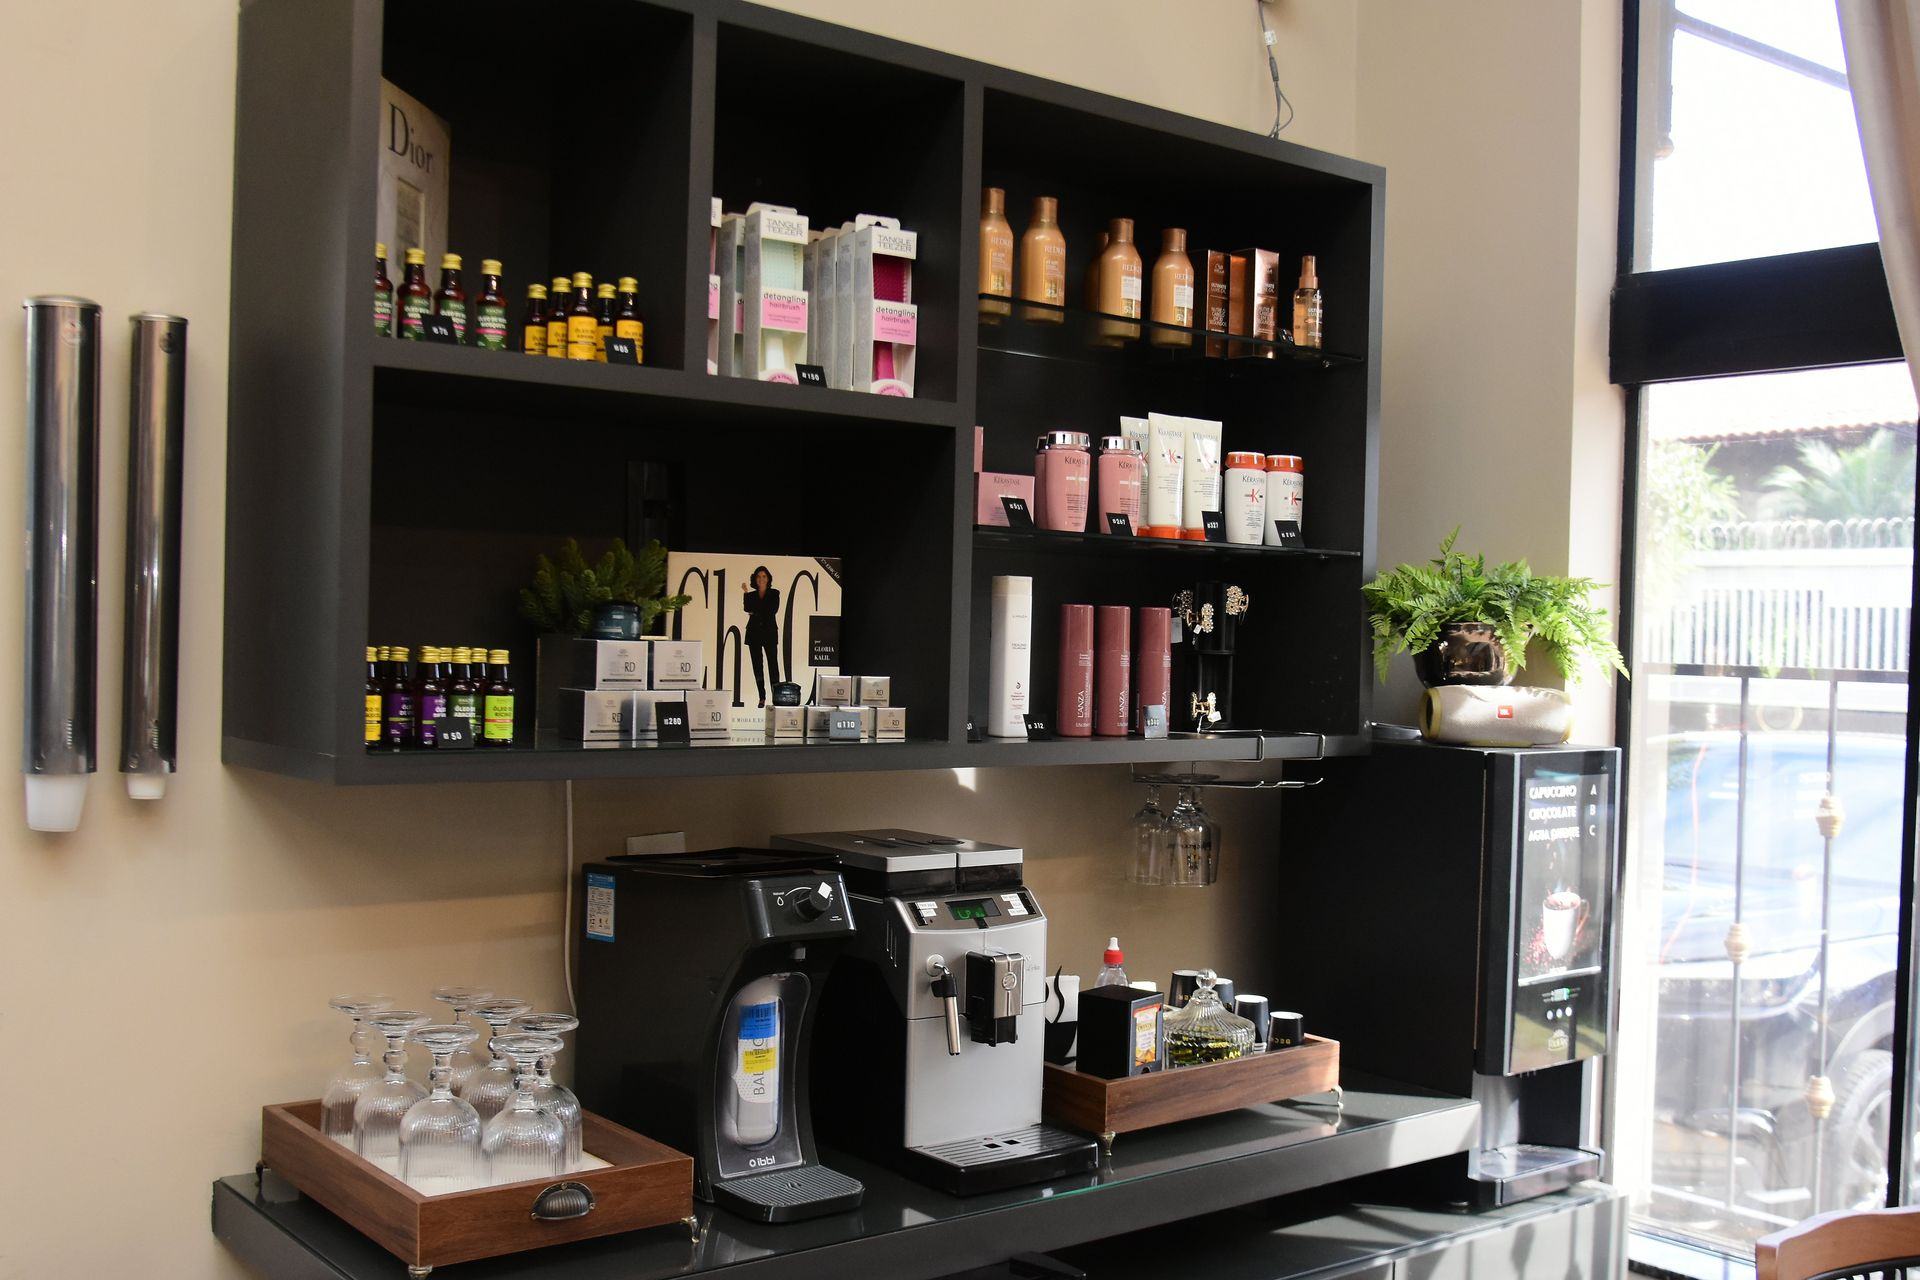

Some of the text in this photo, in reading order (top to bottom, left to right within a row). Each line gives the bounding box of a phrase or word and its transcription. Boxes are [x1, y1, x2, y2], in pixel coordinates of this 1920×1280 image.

[388, 102, 433, 174] Dior
[767, 218, 803, 228] TANGLE
[767, 225, 804, 237] TEEZER
[879, 235, 912, 246] TANGLE
[880, 243, 912, 253] TEEZER
[763, 293, 806, 305] detangling
[769, 302, 800, 311] hairbrush
[876, 306, 916, 319] detangling
[881, 315, 911, 324] hairbrush
[1528, 783, 1597, 800] CAPUCCINO A
[1528, 803, 1597, 821] CHOCOLATE B
[1588, 824, 1596, 836] C
[756, 1155, 776, 1167] ibbl
